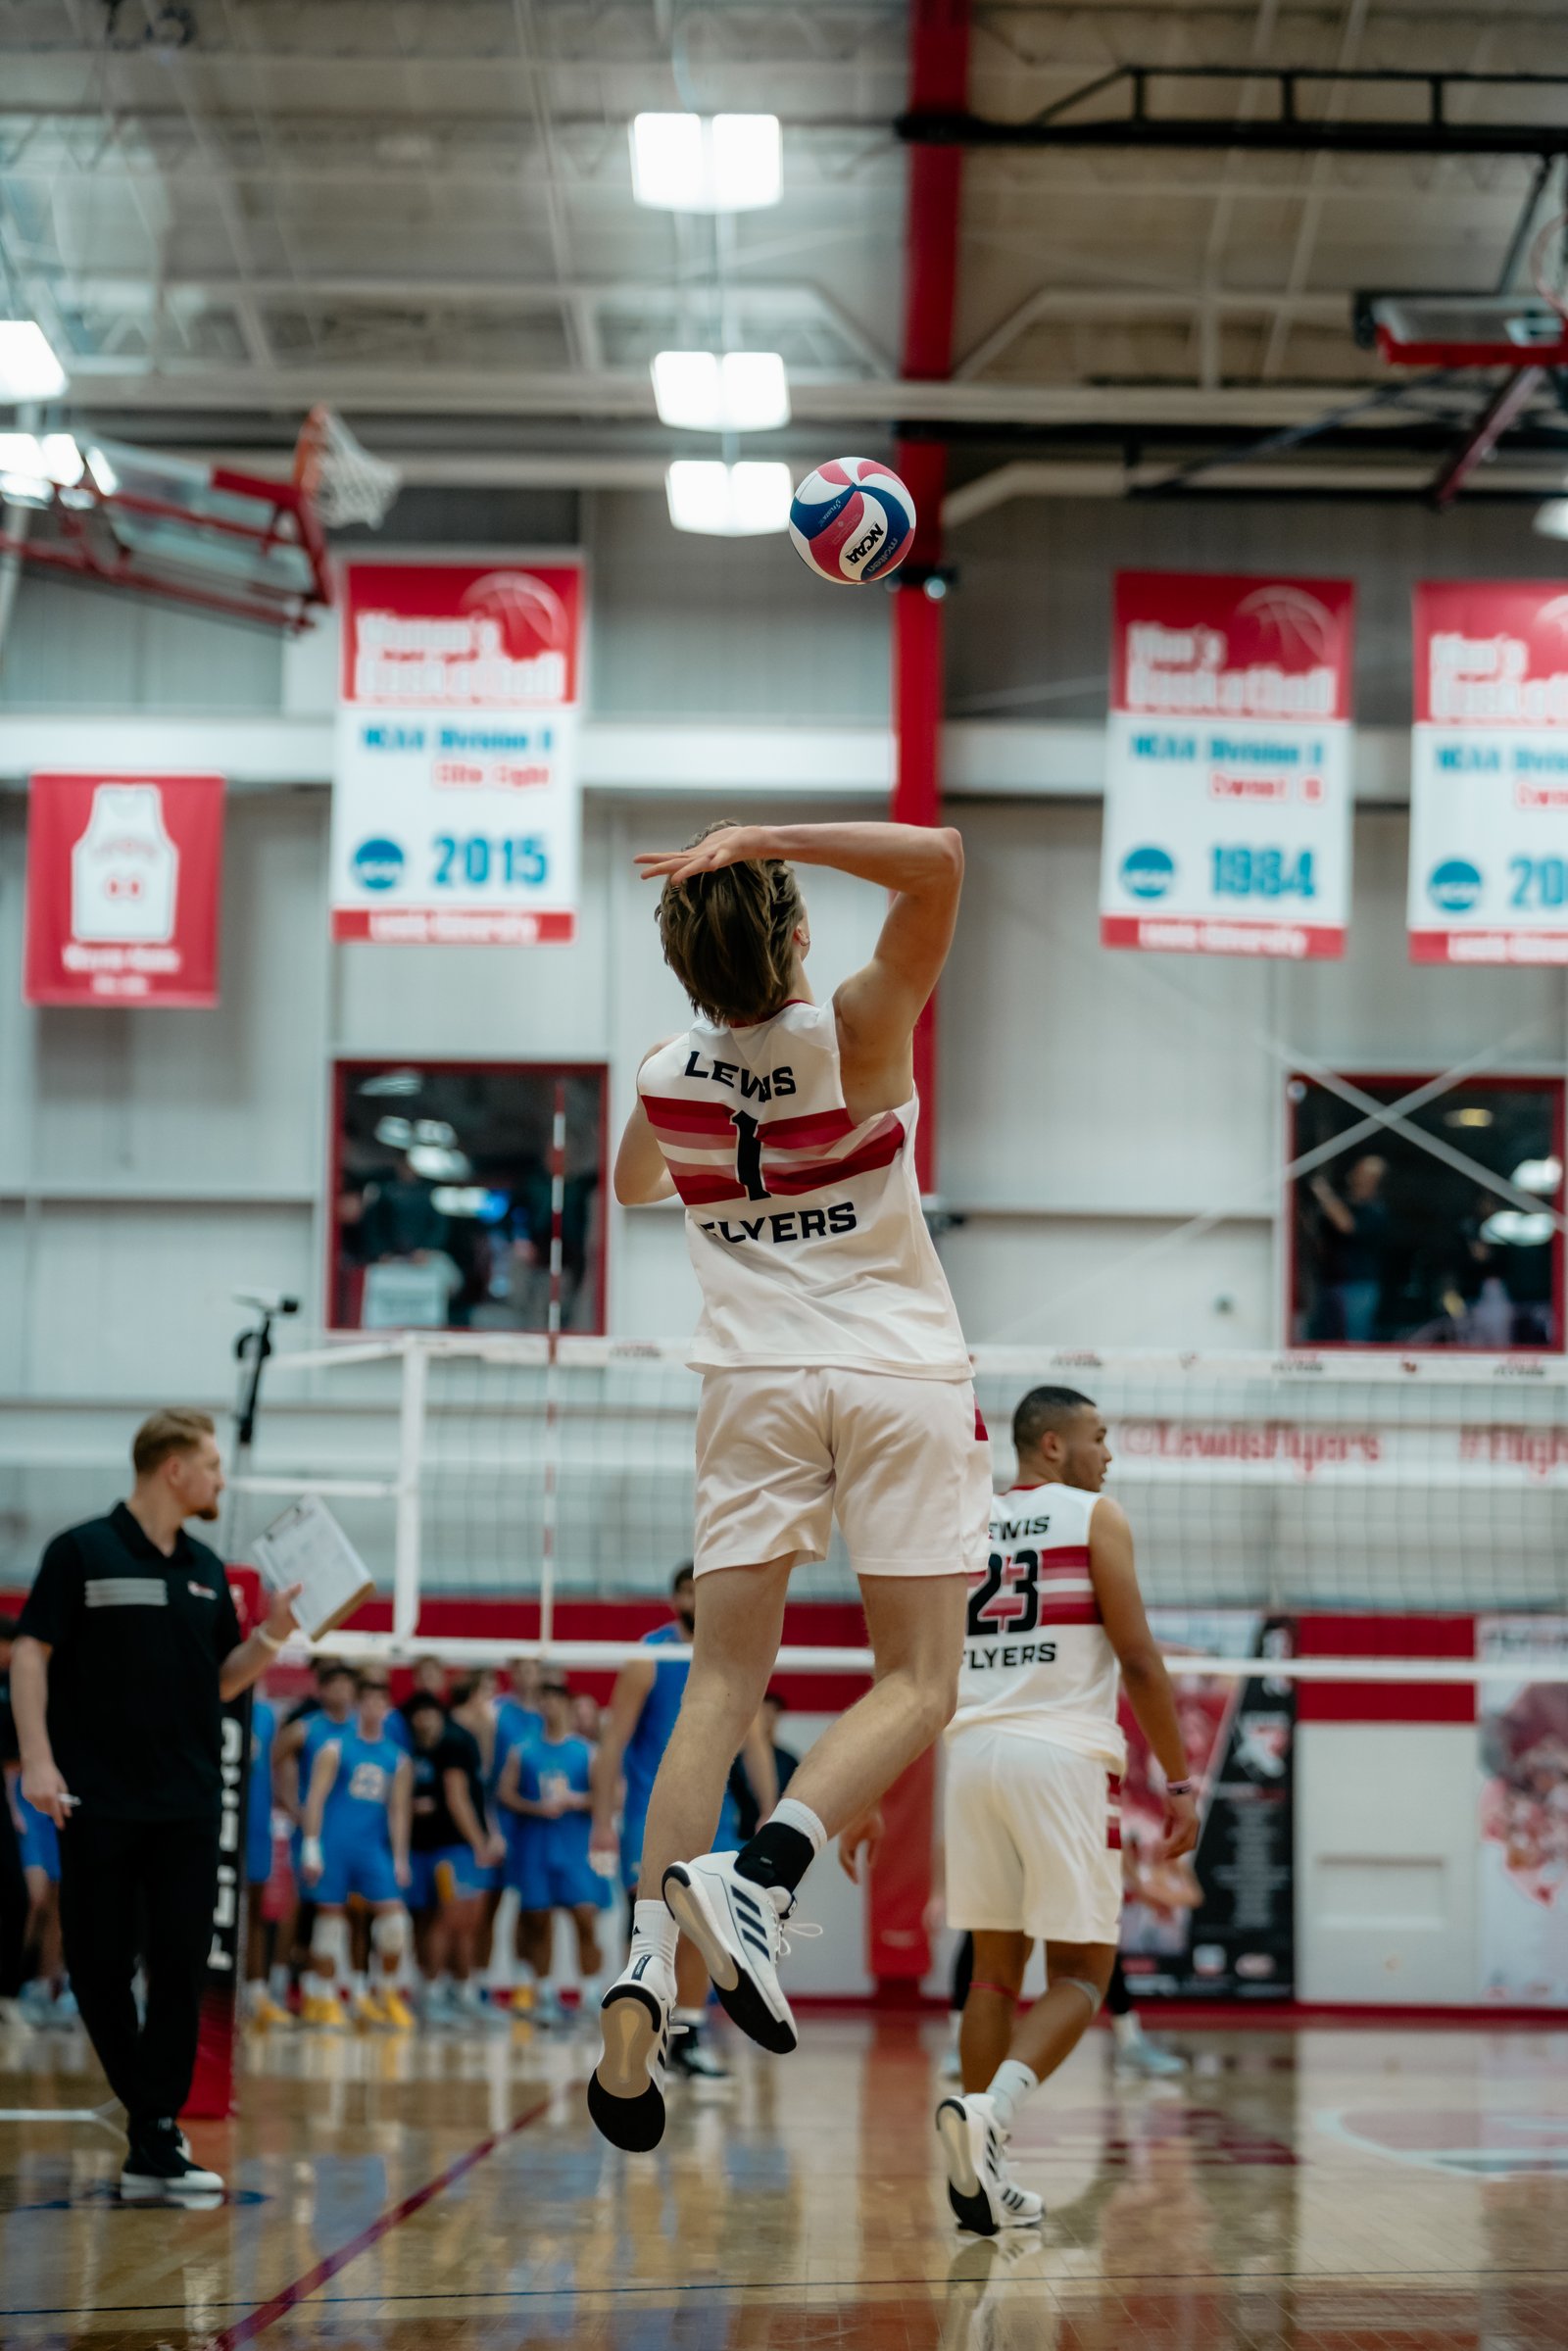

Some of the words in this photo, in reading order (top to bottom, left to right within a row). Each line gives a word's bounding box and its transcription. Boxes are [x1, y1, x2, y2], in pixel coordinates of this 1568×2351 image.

[845, 522, 884, 564] NCAA
[867, 537, 899, 572] molten
[434, 836, 549, 887] 2015
[1212, 846, 1316, 900] 1984
[731, 1109, 772, 1201] 1
[967, 1549, 1039, 1637] 23
[963, 1642, 1056, 1670] LYERS
